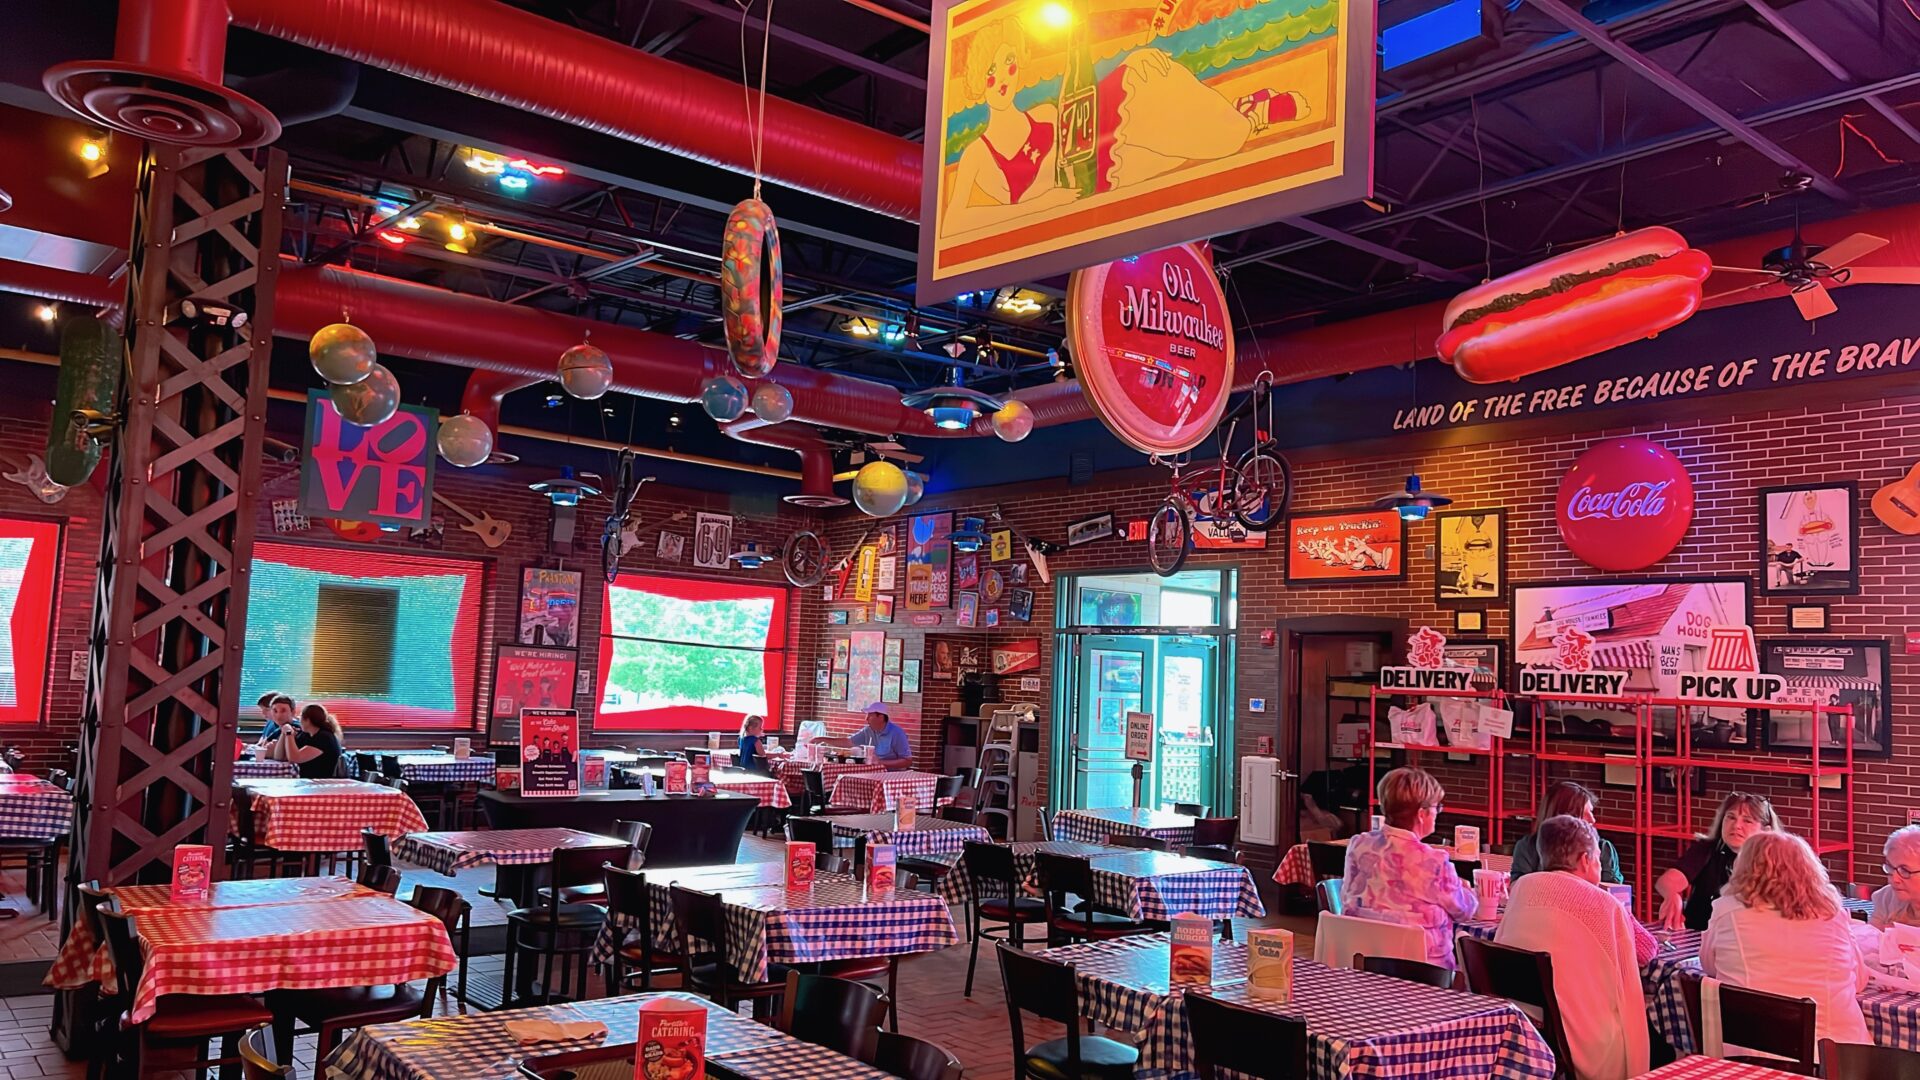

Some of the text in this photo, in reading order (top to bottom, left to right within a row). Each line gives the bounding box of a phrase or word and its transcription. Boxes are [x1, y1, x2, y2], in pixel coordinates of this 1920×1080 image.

[1162, 261, 1200, 303] Old
[1119, 285, 1224, 350] Milwaukee
[1169, 343, 1197, 358] BEER
[1393, 404, 1446, 430] LAND
[1449, 400, 1478, 423] OF
[1483, 392, 1526, 419] THE
[1528, 384, 1587, 413] FREE
[1594, 366, 1714, 405] BECAUSE
[1717, 358, 1758, 388] OF
[1771, 349, 1831, 382] THE
[1568, 478, 1676, 521] Coca-Cola
[1128, 520, 1149, 541] EXIT
[1296, 525, 1320, 535] Keep
[696, 523, 731, 565] 69
[910, 593, 928, 605] HERE
[1686, 611, 1712, 628] DOG
[1677, 625, 1708, 639] HOUS
[540, 652, 567, 660] HIRING!
[1660, 656, 1679, 667] BEST
[1382, 669, 1470, 690] DELIVERY
[1522, 672, 1624, 695] DELIVERY
[1681, 675, 1781, 700] PICK UP
[1130, 721, 1150, 731] ONLINE
[1130, 731, 1148, 740] ORDER
[1174, 933, 1210, 942] BURGER
[1177, 926, 1208, 935] RODEO
[1254, 936, 1284, 950] Lemon
[1258, 946, 1280, 957] Cake
[651, 1026, 695, 1038] CATERING
